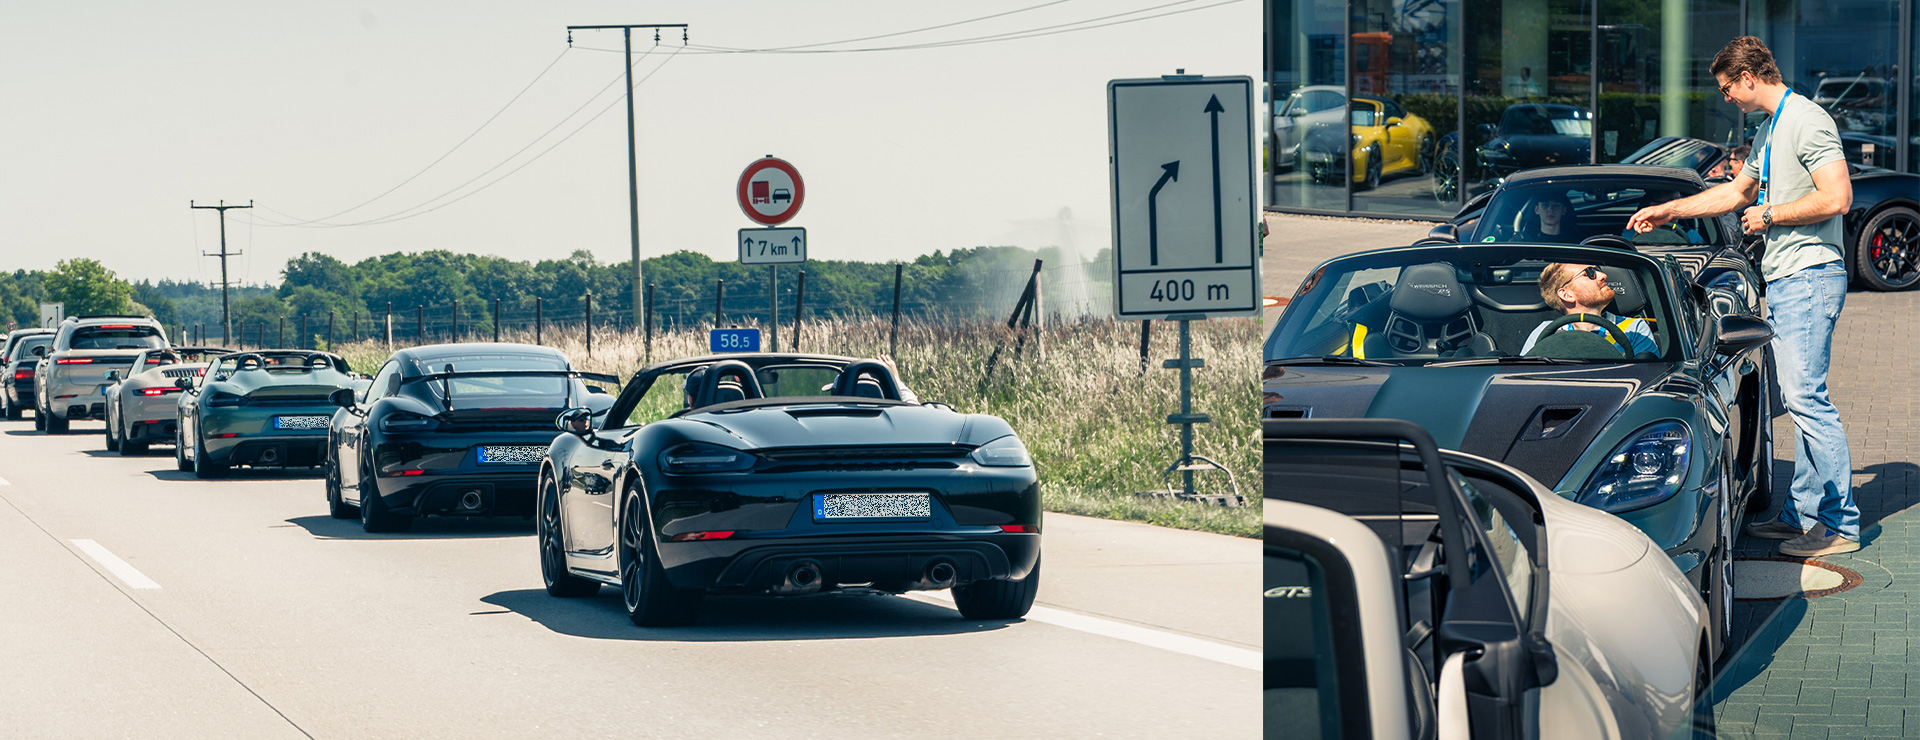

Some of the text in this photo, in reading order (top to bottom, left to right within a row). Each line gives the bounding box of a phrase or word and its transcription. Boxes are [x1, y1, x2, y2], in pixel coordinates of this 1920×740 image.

[758, 240, 787, 256] 7 km
[1150, 279, 1229, 302] 400 m
[720, 333, 750, 349] 58.5
[1263, 586, 1312, 598] GTS
